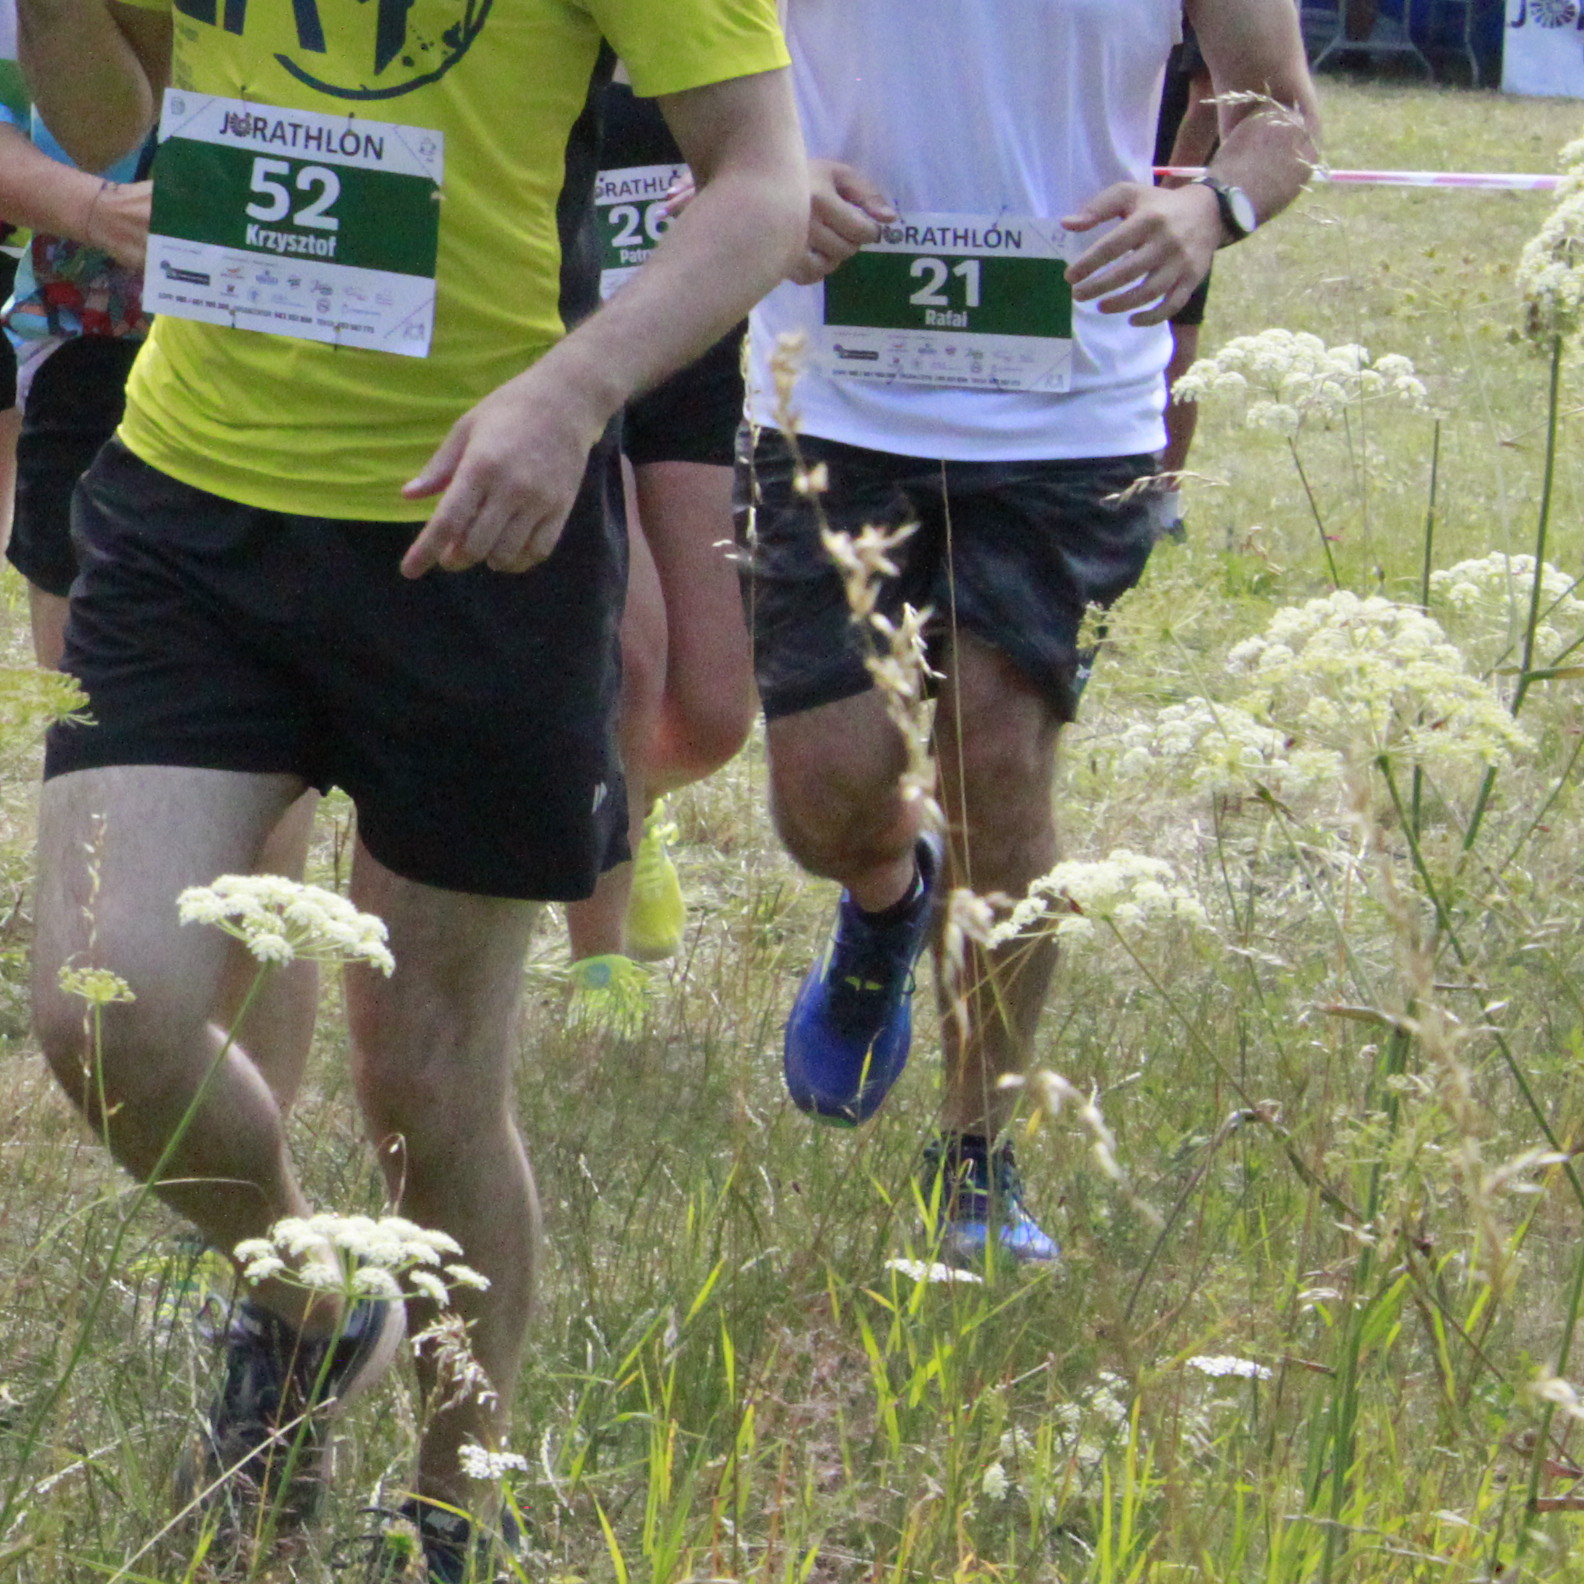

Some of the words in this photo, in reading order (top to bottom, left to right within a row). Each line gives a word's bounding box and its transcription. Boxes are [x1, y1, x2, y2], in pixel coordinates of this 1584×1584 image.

[245, 156, 342, 231] 52
[245, 222, 338, 259] Krzysztof
[909, 257, 981, 308] 21
